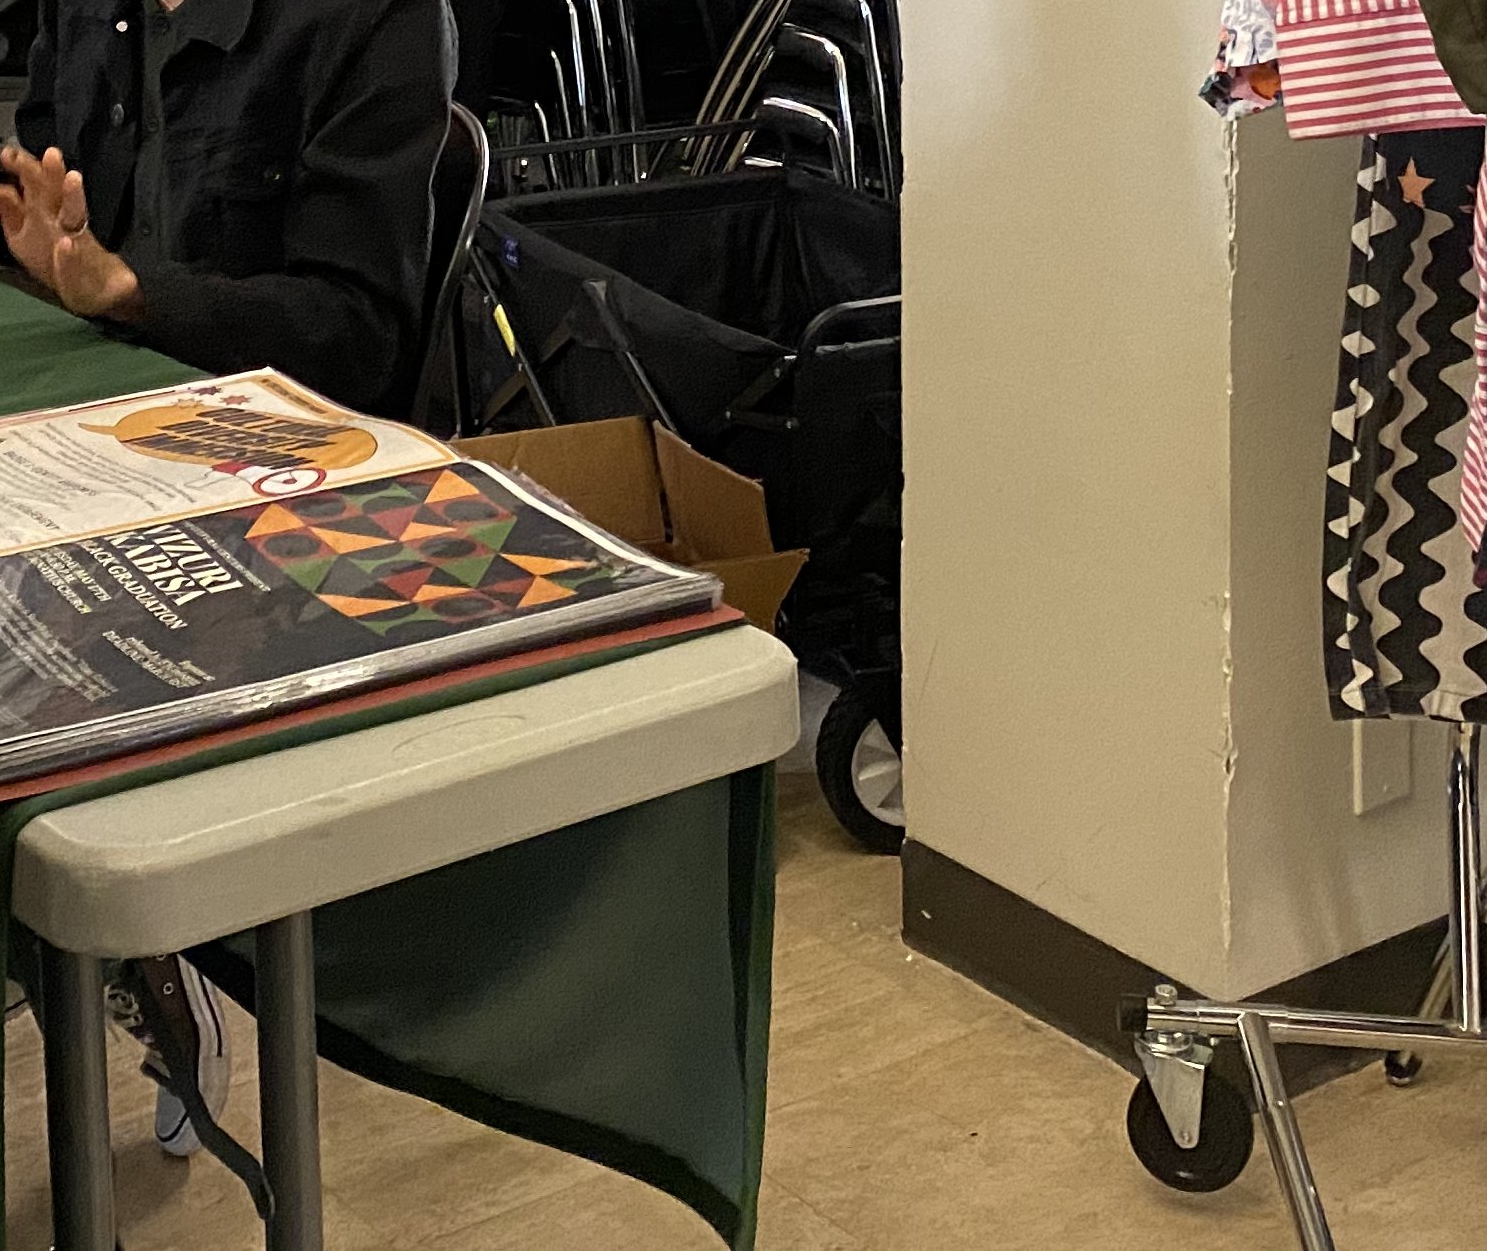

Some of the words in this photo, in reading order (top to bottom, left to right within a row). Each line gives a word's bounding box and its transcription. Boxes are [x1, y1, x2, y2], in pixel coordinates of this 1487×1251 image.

[102, 531, 207, 606] KABISA
[141, 524, 244, 594] VIZURI
[107, 564, 189, 630] GRADUATION
